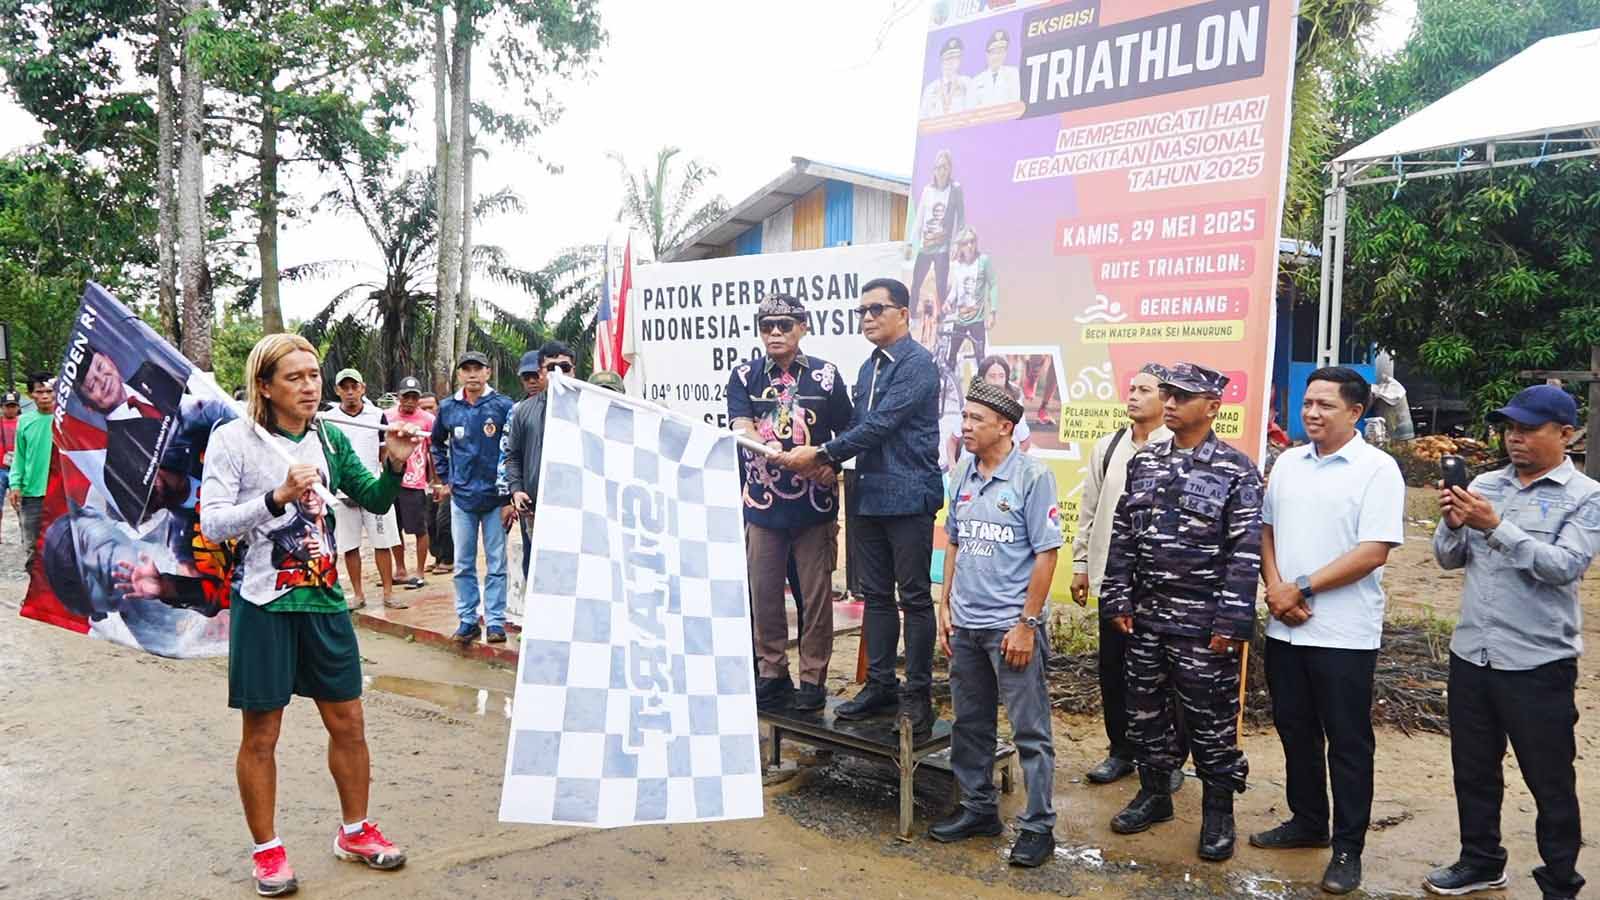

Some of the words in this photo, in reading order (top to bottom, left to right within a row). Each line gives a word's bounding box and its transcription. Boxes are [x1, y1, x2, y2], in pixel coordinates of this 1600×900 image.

[1028, 9, 1095, 37] EKSIBISI
[1026, 6, 1260, 104] TRIATHLON
[1059, 112, 1206, 149] MEMPERINGATI
[1212, 100, 1266, 124] HARI
[1015, 147, 1146, 180] KEBANGKITAN
[1153, 128, 1263, 160] NASIONAL
[1131, 164, 1201, 190] TAHUN
[1206, 156, 1261, 181] 2025
[1063, 223, 1124, 248] KAMIS,
[1131, 219, 1154, 242] 29
[1162, 216, 1196, 239] MEI
[1204, 209, 1256, 234] 2025
[1101, 258, 1140, 280] RUTE
[1147, 254, 1247, 278] TRIATHLON:
[644, 284, 702, 311] PATOK
[712, 272, 859, 307] PERBATASAN
[1140, 296, 1228, 316] BERENANG
[80, 303, 97, 330] RI
[957, 518, 1016, 545] LTARA
